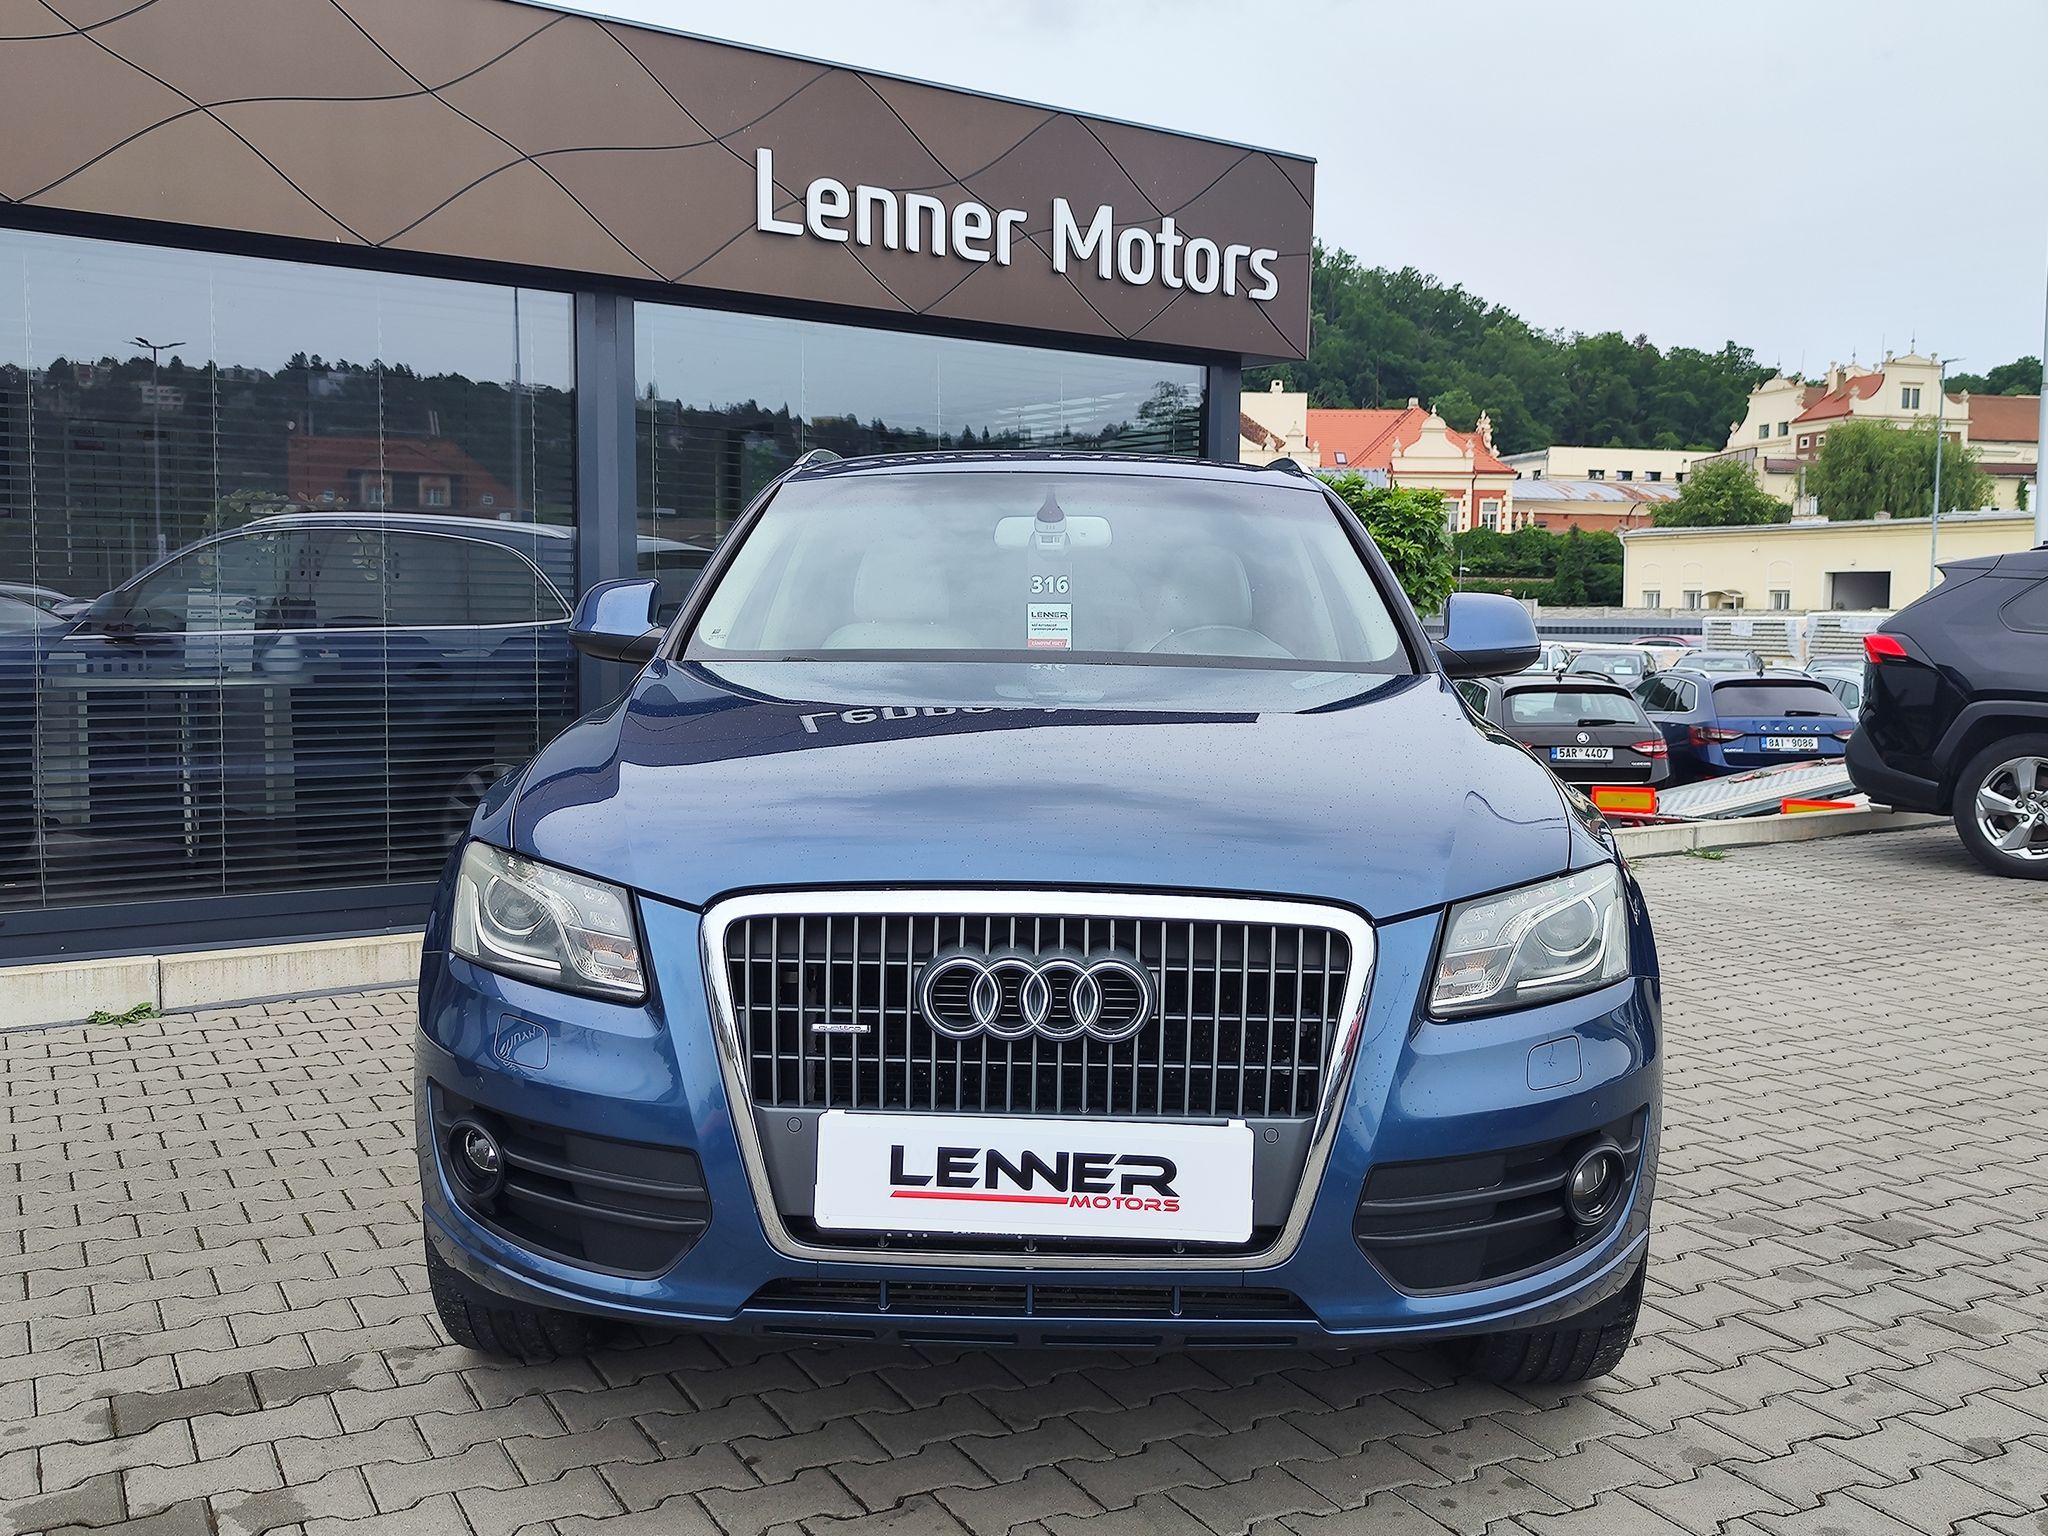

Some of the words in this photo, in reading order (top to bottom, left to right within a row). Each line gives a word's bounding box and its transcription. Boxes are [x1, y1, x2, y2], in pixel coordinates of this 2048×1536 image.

[756, 147, 1027, 266] Lenner
[1051, 197, 1279, 301] Motors
[1031, 574, 1069, 594] 316
[1559, 748, 1577, 758] 5AR
[1585, 749, 1609, 758] 4407
[889, 1144, 1180, 1197] LENNER
[1069, 1195, 1180, 1212] MOTORS
